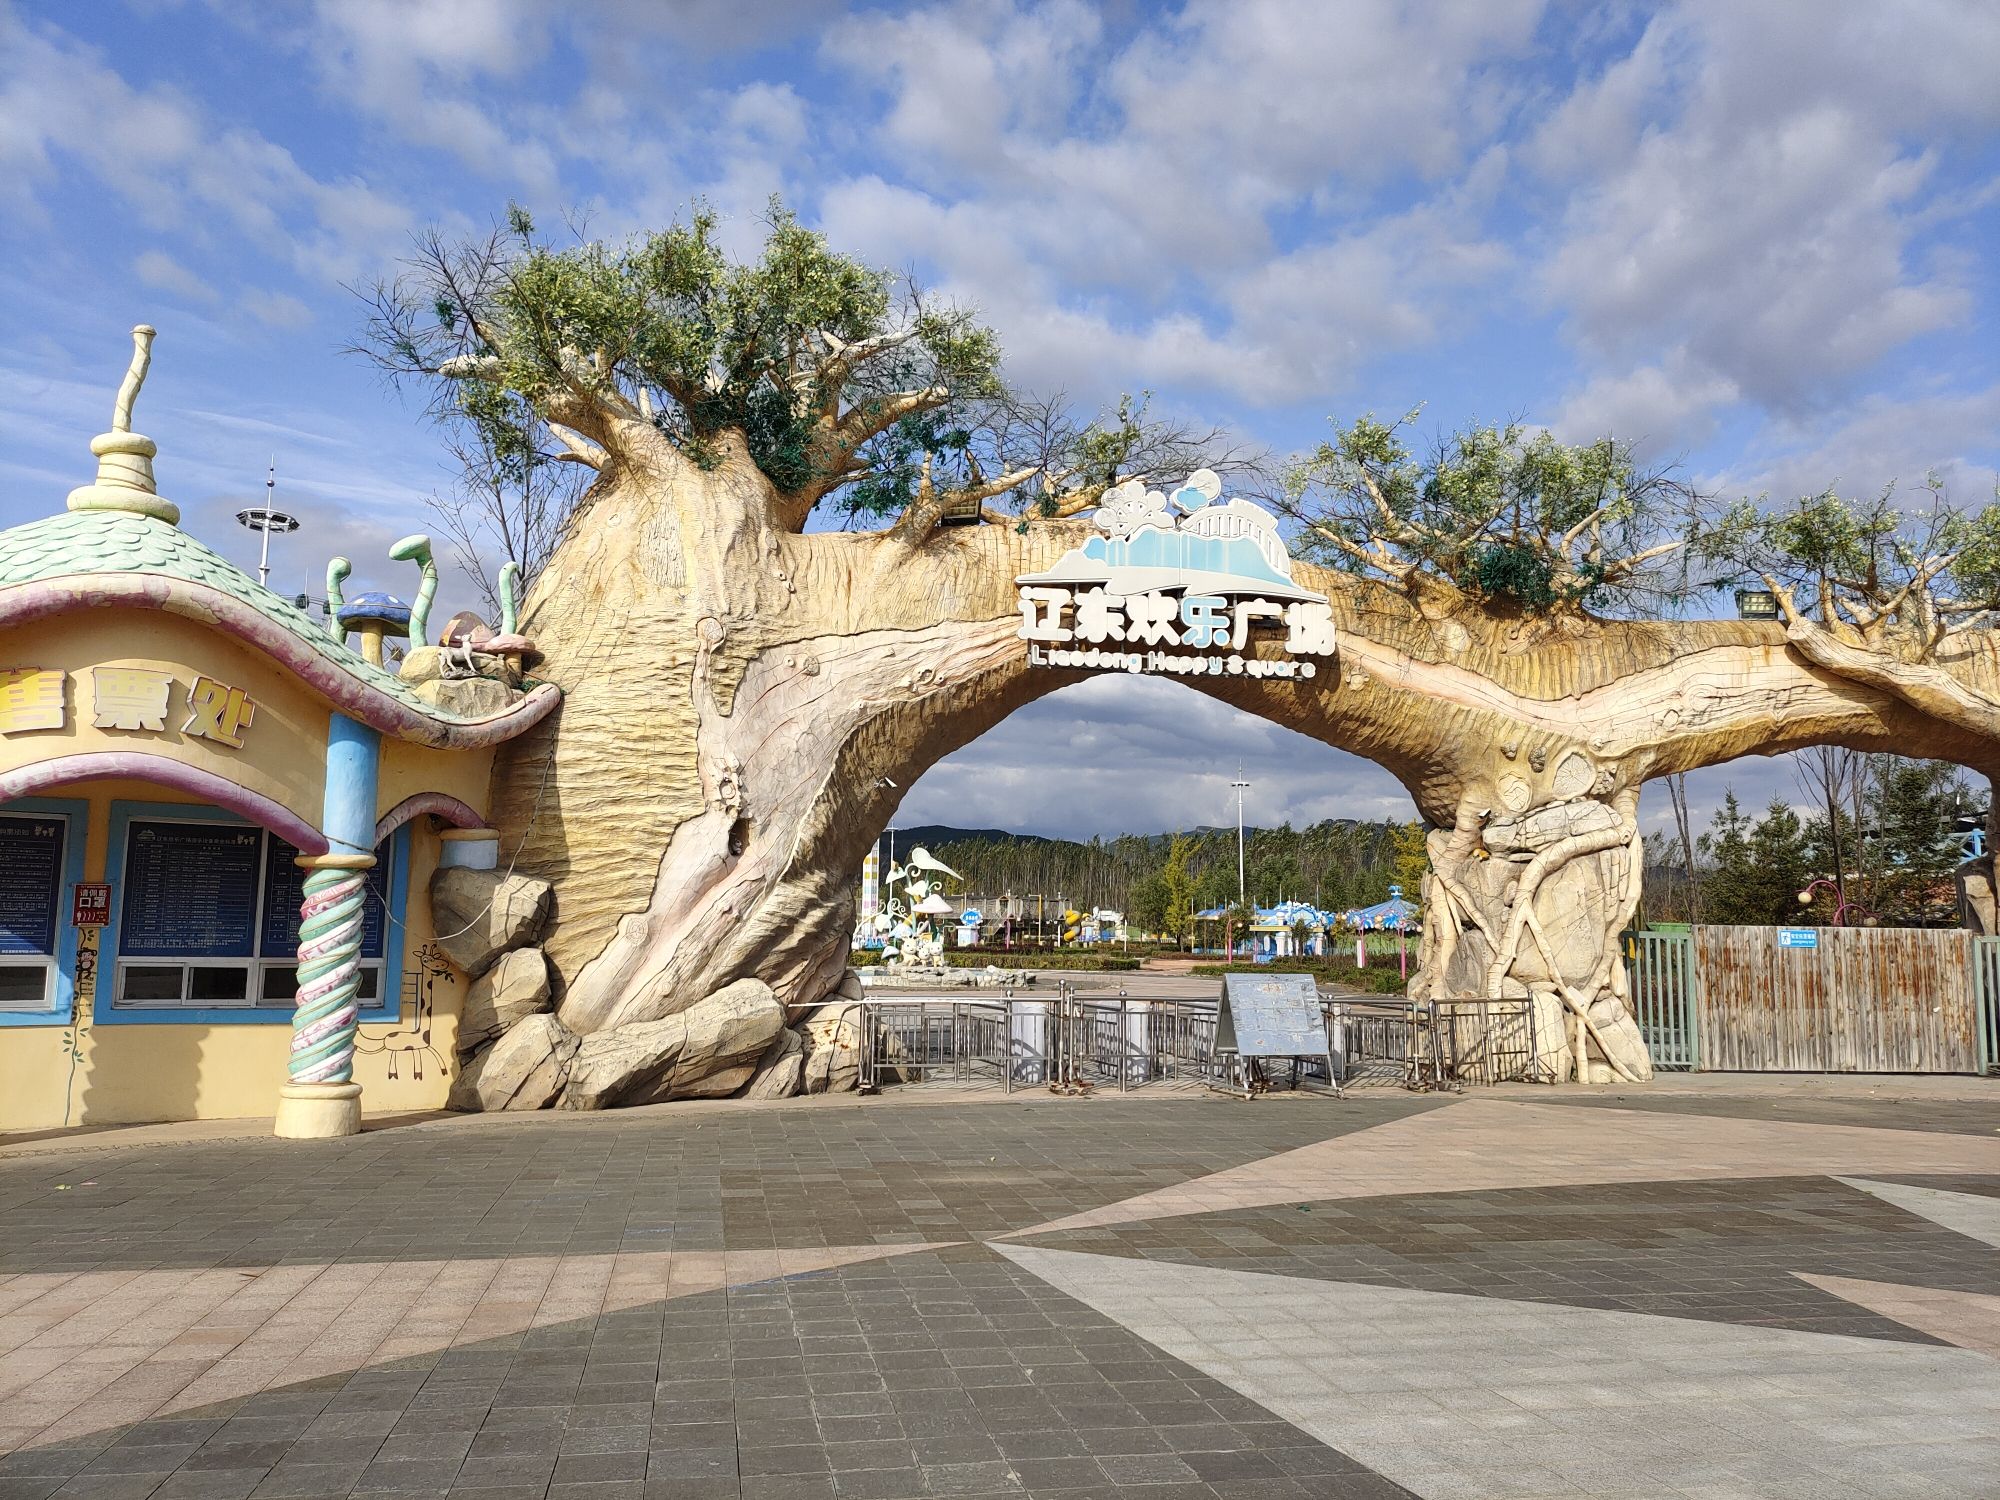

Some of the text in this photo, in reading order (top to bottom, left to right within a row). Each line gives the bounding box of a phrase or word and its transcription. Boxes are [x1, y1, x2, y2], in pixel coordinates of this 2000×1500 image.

[1017, 585, 1336, 656] 辽东欢乐广场
[1032, 645, 1316, 678] Liaodong Happy Square
[0, 667, 255, 749] 售票处
[79, 896, 106, 908] 口罩
